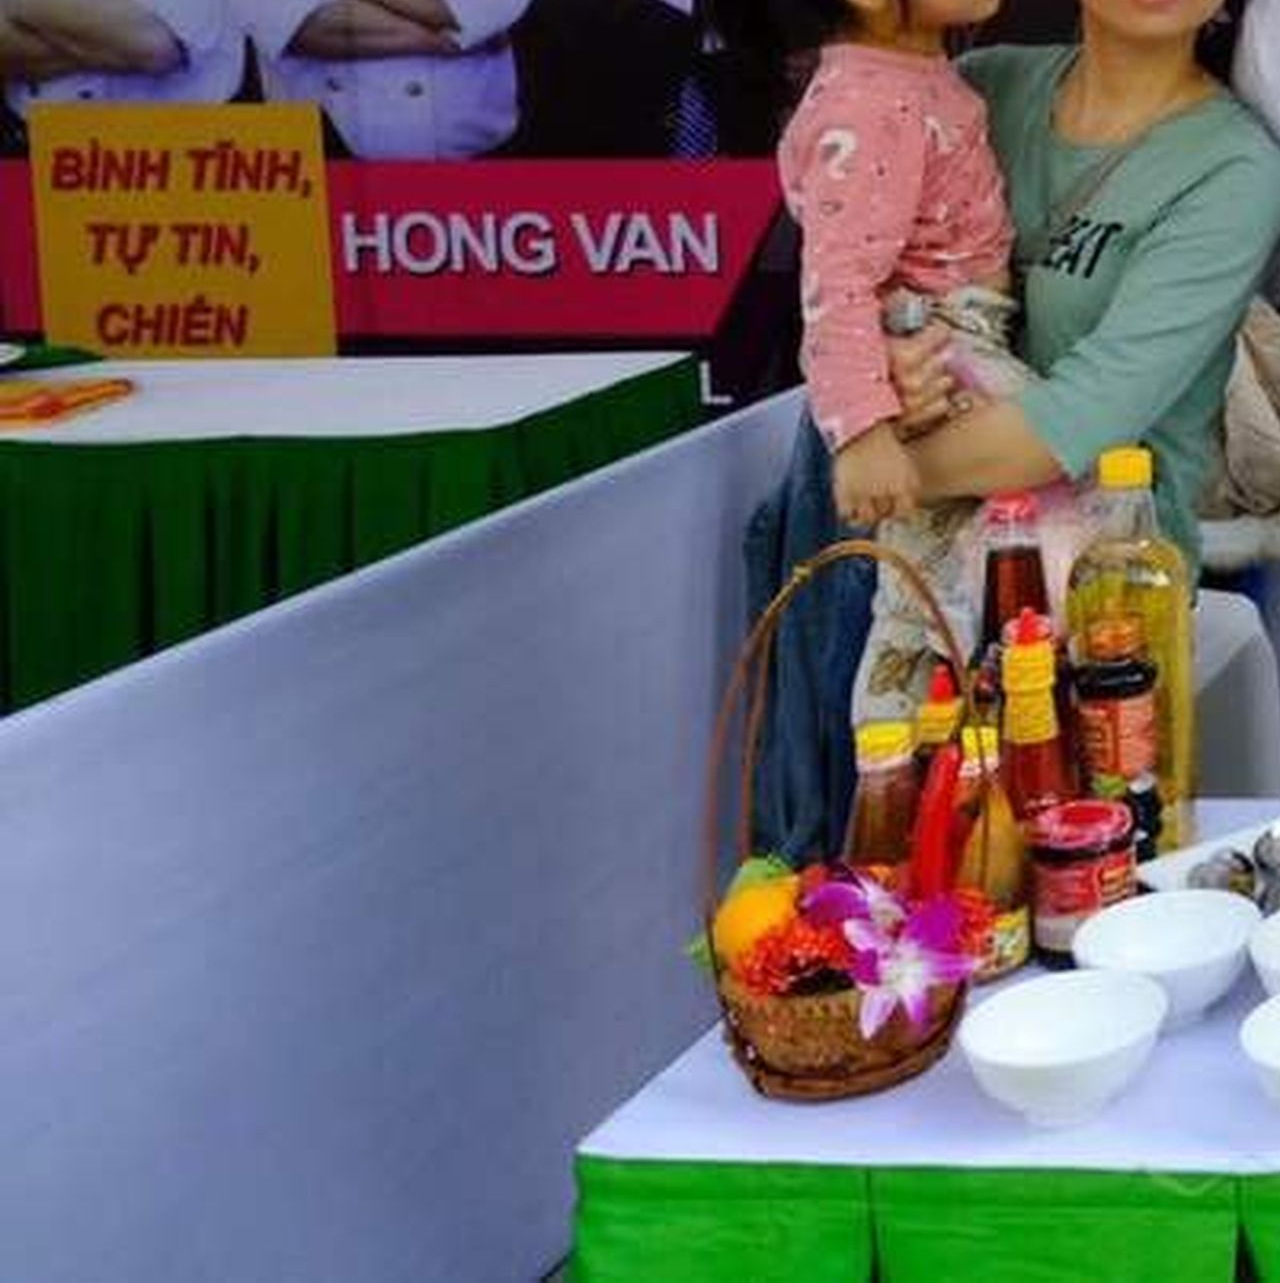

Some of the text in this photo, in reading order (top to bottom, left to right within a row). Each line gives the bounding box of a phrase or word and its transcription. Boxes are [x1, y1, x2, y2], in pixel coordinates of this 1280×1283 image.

[171, 224, 261, 277] TIN,
[343, 212, 719, 274] HONG VAN
